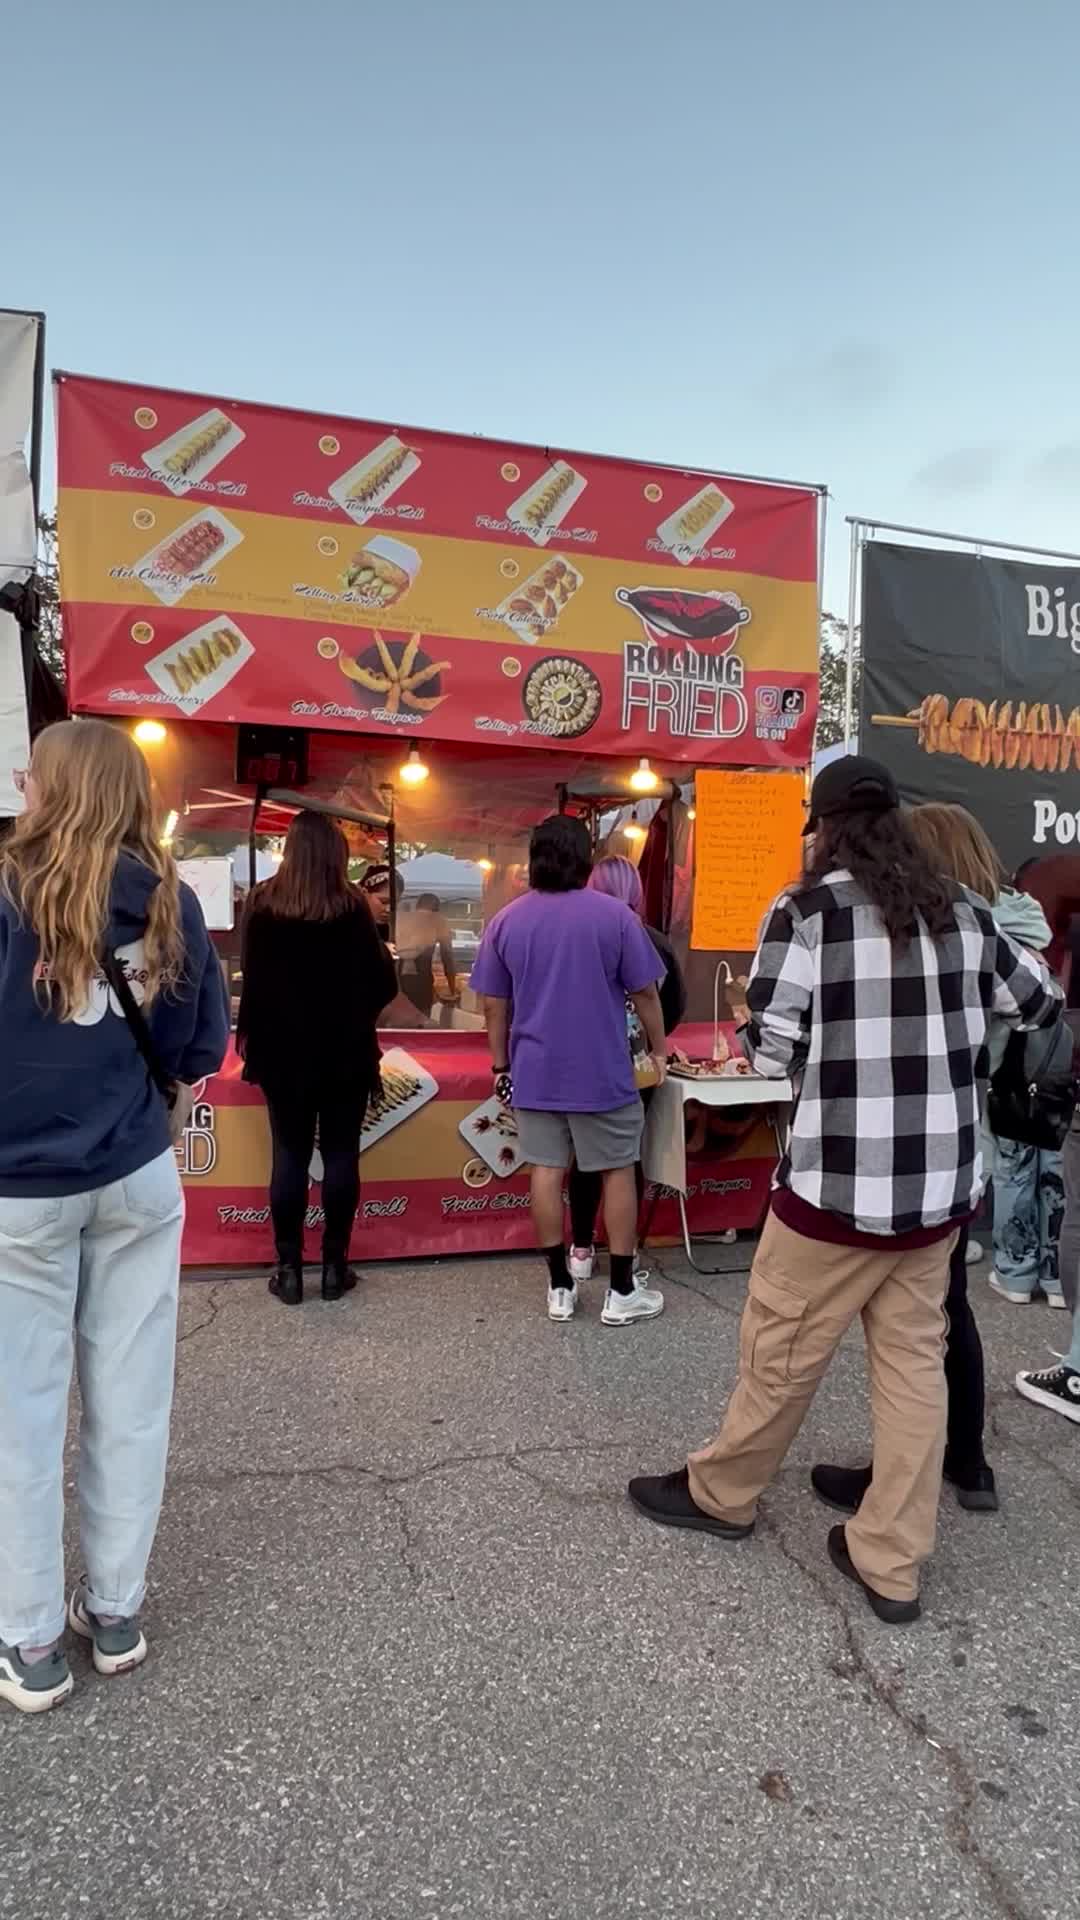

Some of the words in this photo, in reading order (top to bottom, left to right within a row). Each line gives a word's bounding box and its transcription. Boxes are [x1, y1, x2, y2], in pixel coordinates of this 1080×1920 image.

[624, 641, 744, 688] ROLLING
[621, 675, 749, 739] FRIED
[755, 713, 799, 730] FOLLOW
[756, 728, 769, 739] US
[770, 729, 787, 741] ON
[218, 1206, 272, 1224] Fried
[362, 1196, 408, 1218] Roll
[441, 1195, 488, 1214] Fried
